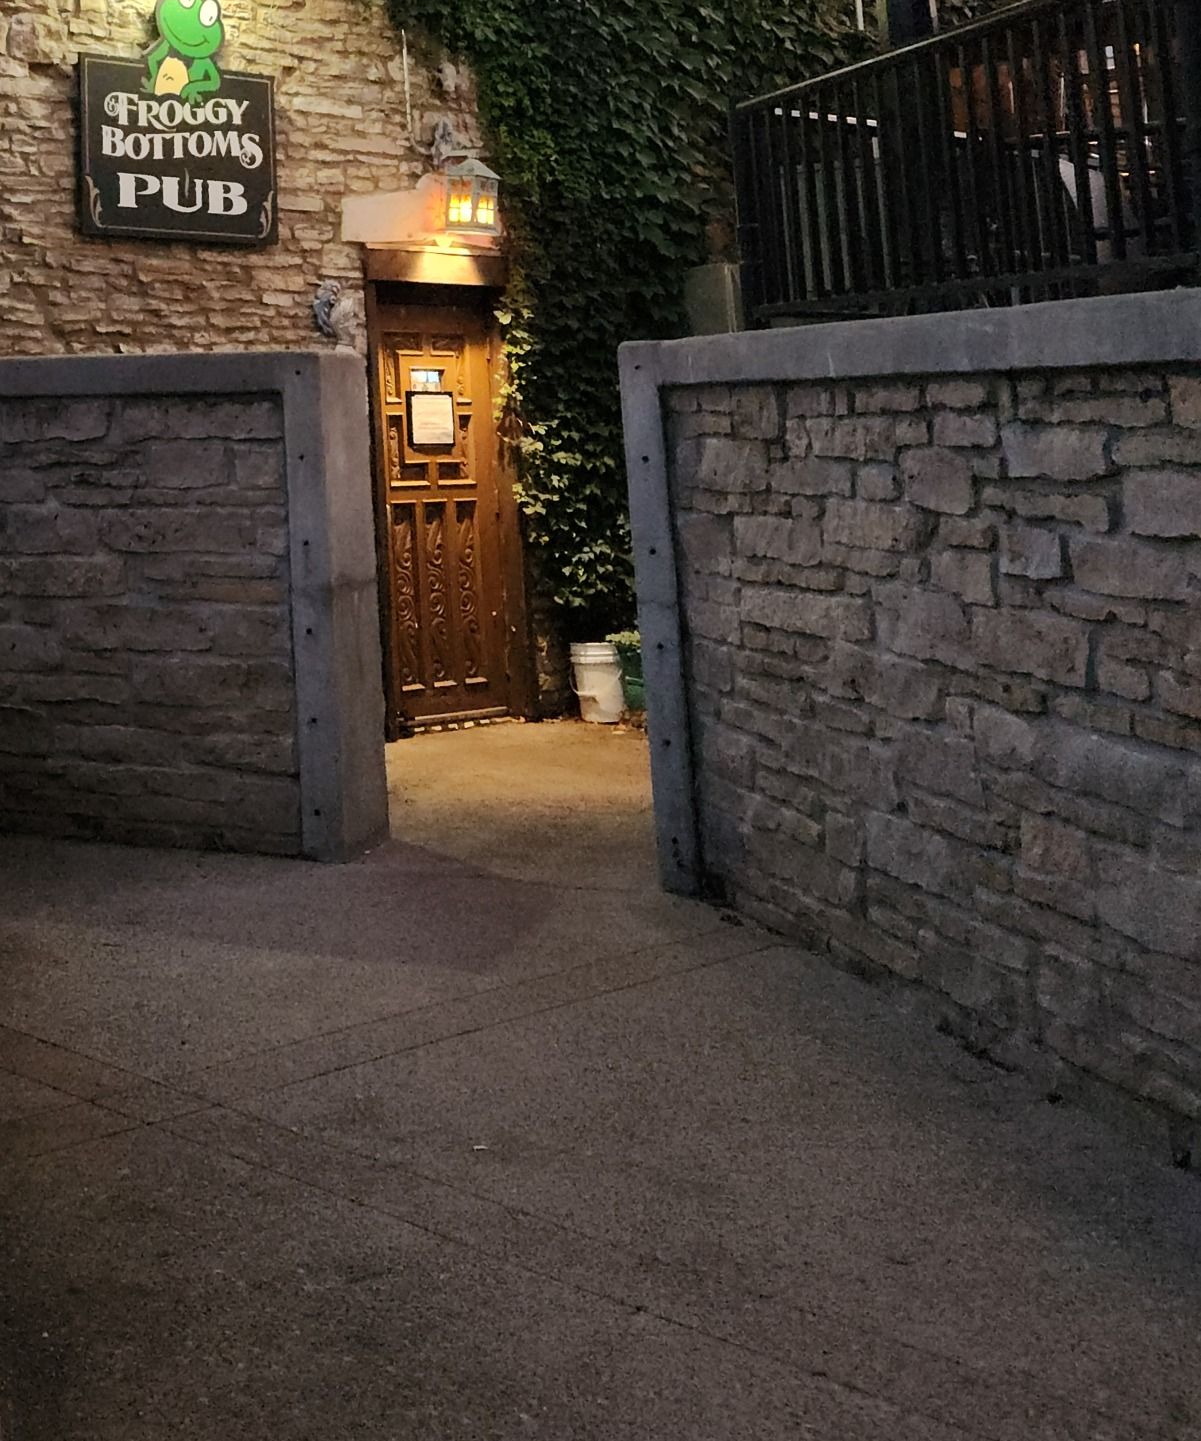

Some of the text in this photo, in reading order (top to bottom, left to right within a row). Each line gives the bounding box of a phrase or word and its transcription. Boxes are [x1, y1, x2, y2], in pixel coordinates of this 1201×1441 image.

[103, 91, 250, 132] FROGGY
[101, 125, 264, 169] BOTTOMS
[117, 172, 248, 216] PUB
